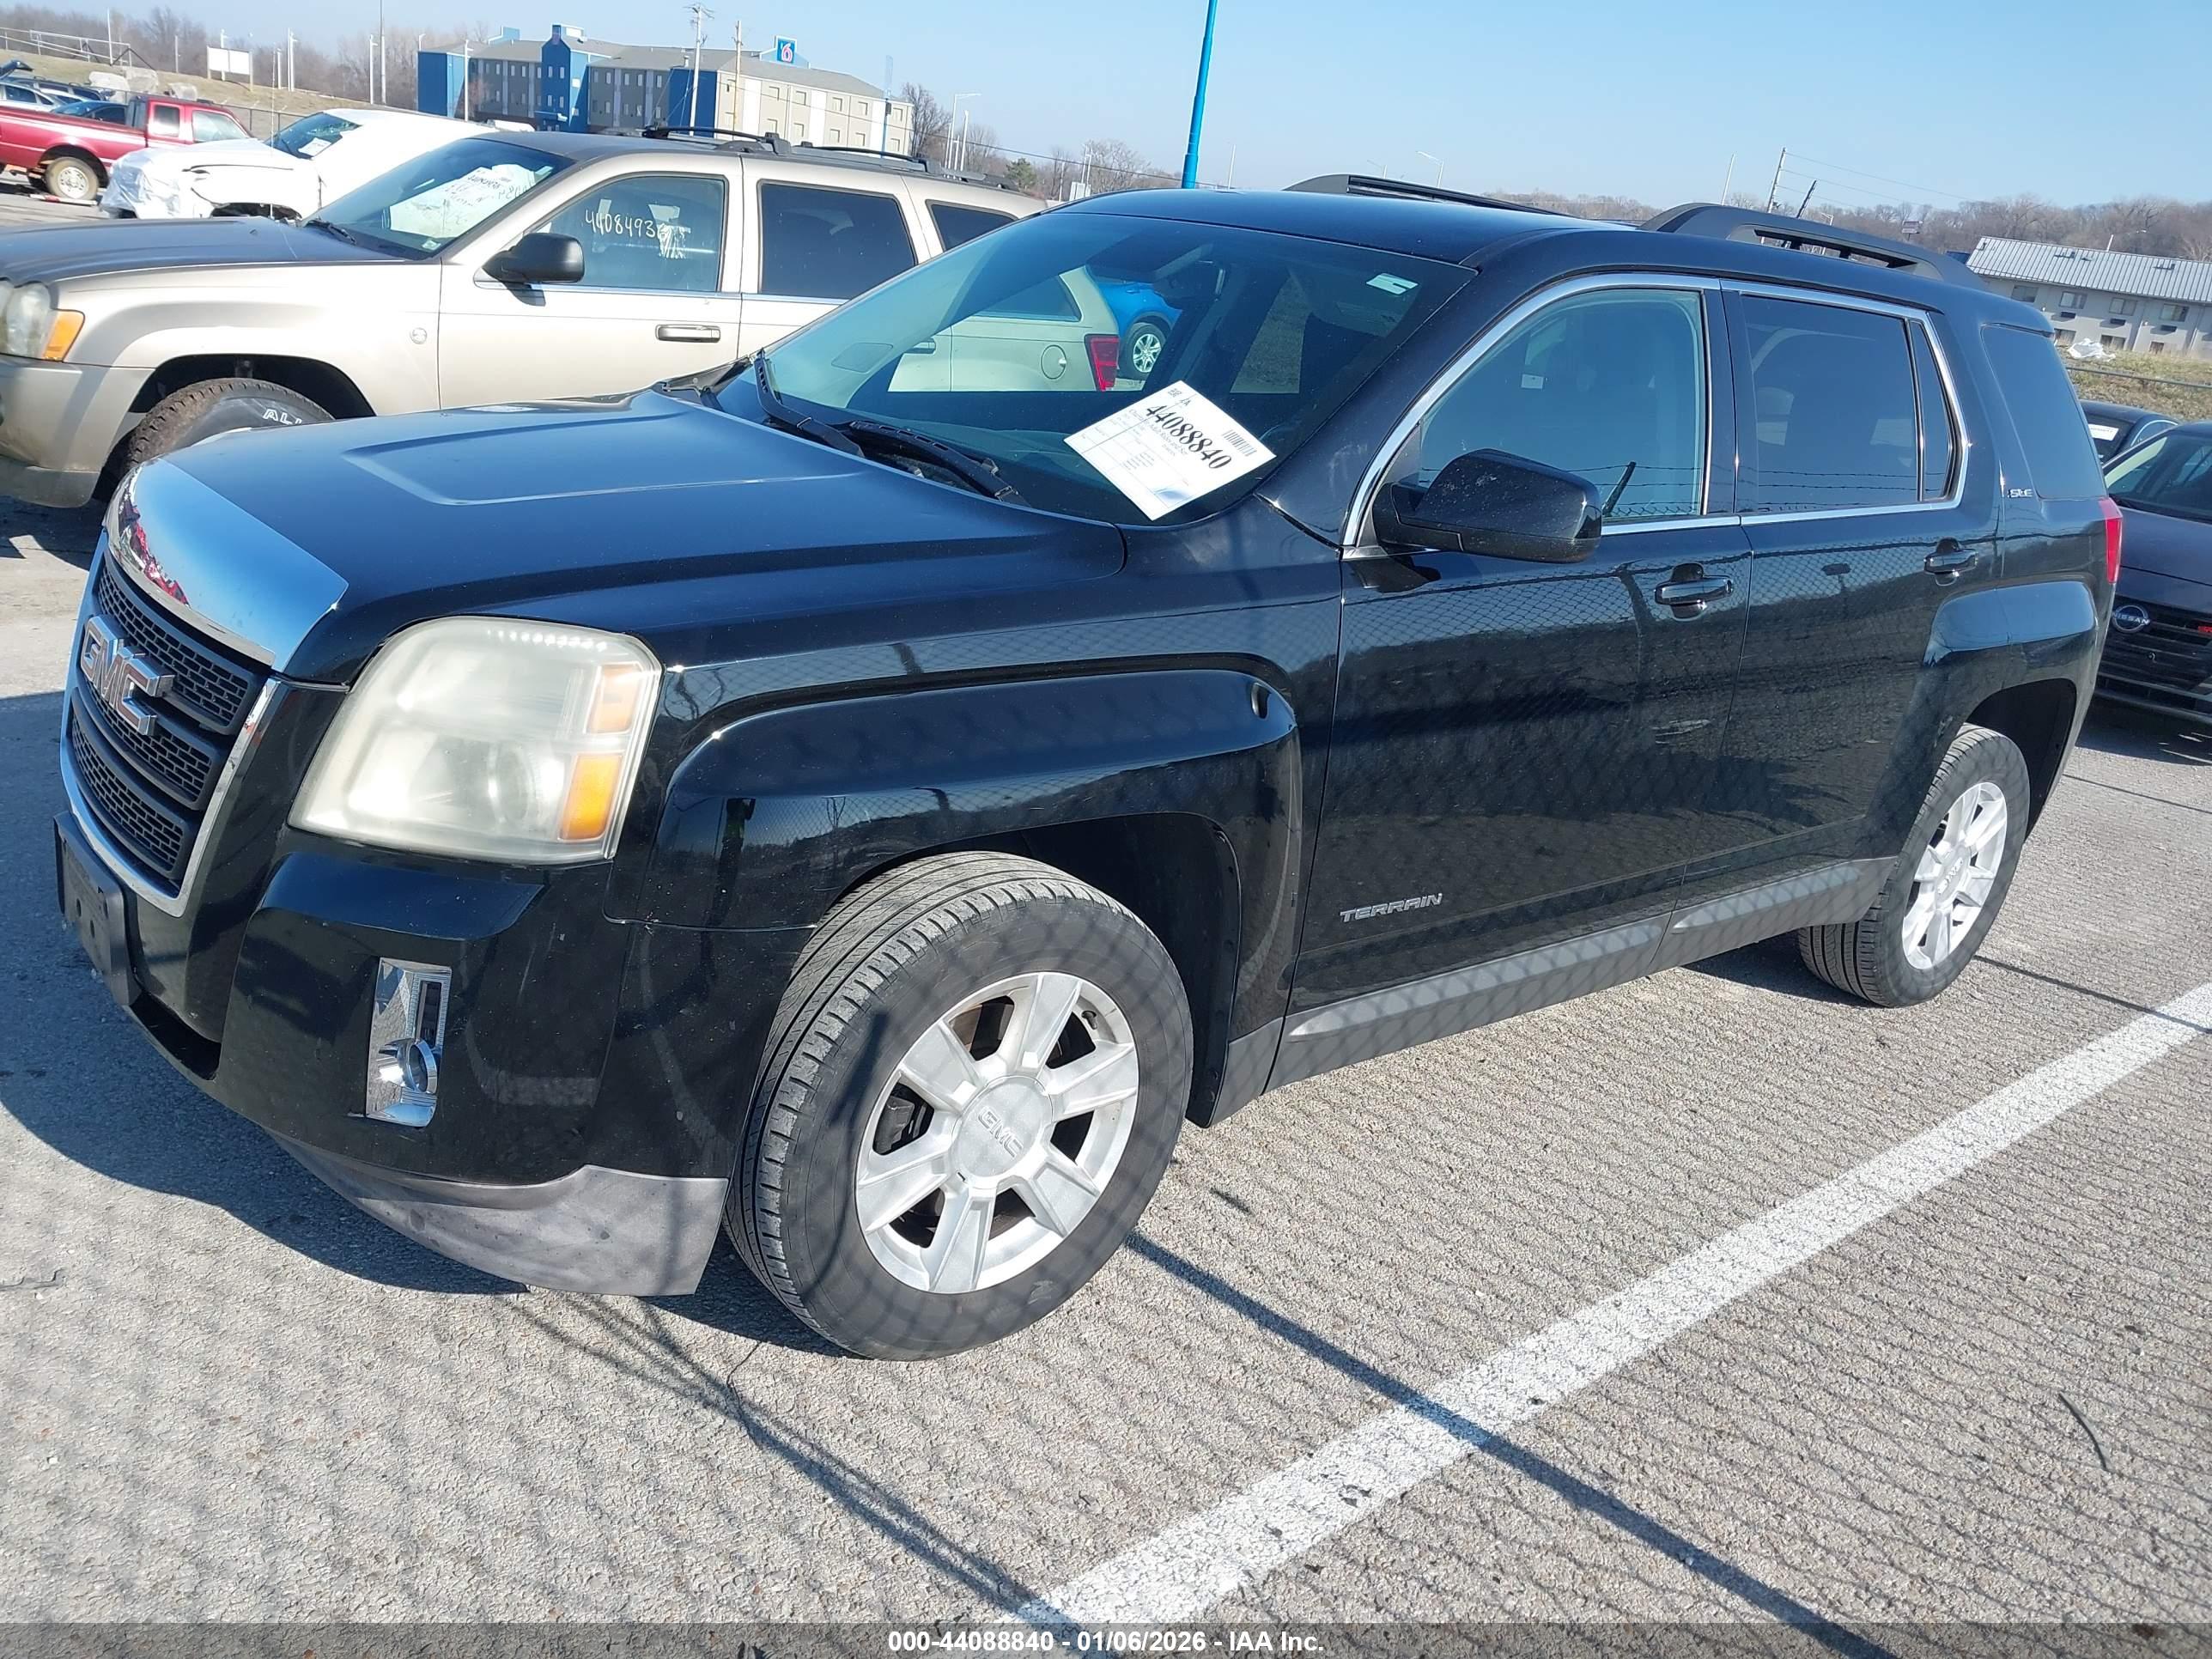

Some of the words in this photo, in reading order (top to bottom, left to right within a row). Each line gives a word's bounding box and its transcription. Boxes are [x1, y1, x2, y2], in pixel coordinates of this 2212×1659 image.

[781, 43, 793, 63] 6
[1146, 404, 1232, 470] 44088840
[2009, 488, 2033, 498] SLE
[2112, 611, 2151, 626] NISSAN
[80, 614, 161, 736] GMC
[1339, 892, 1443, 923] TERRAIN
[977, 1106, 1024, 1159] GMC
